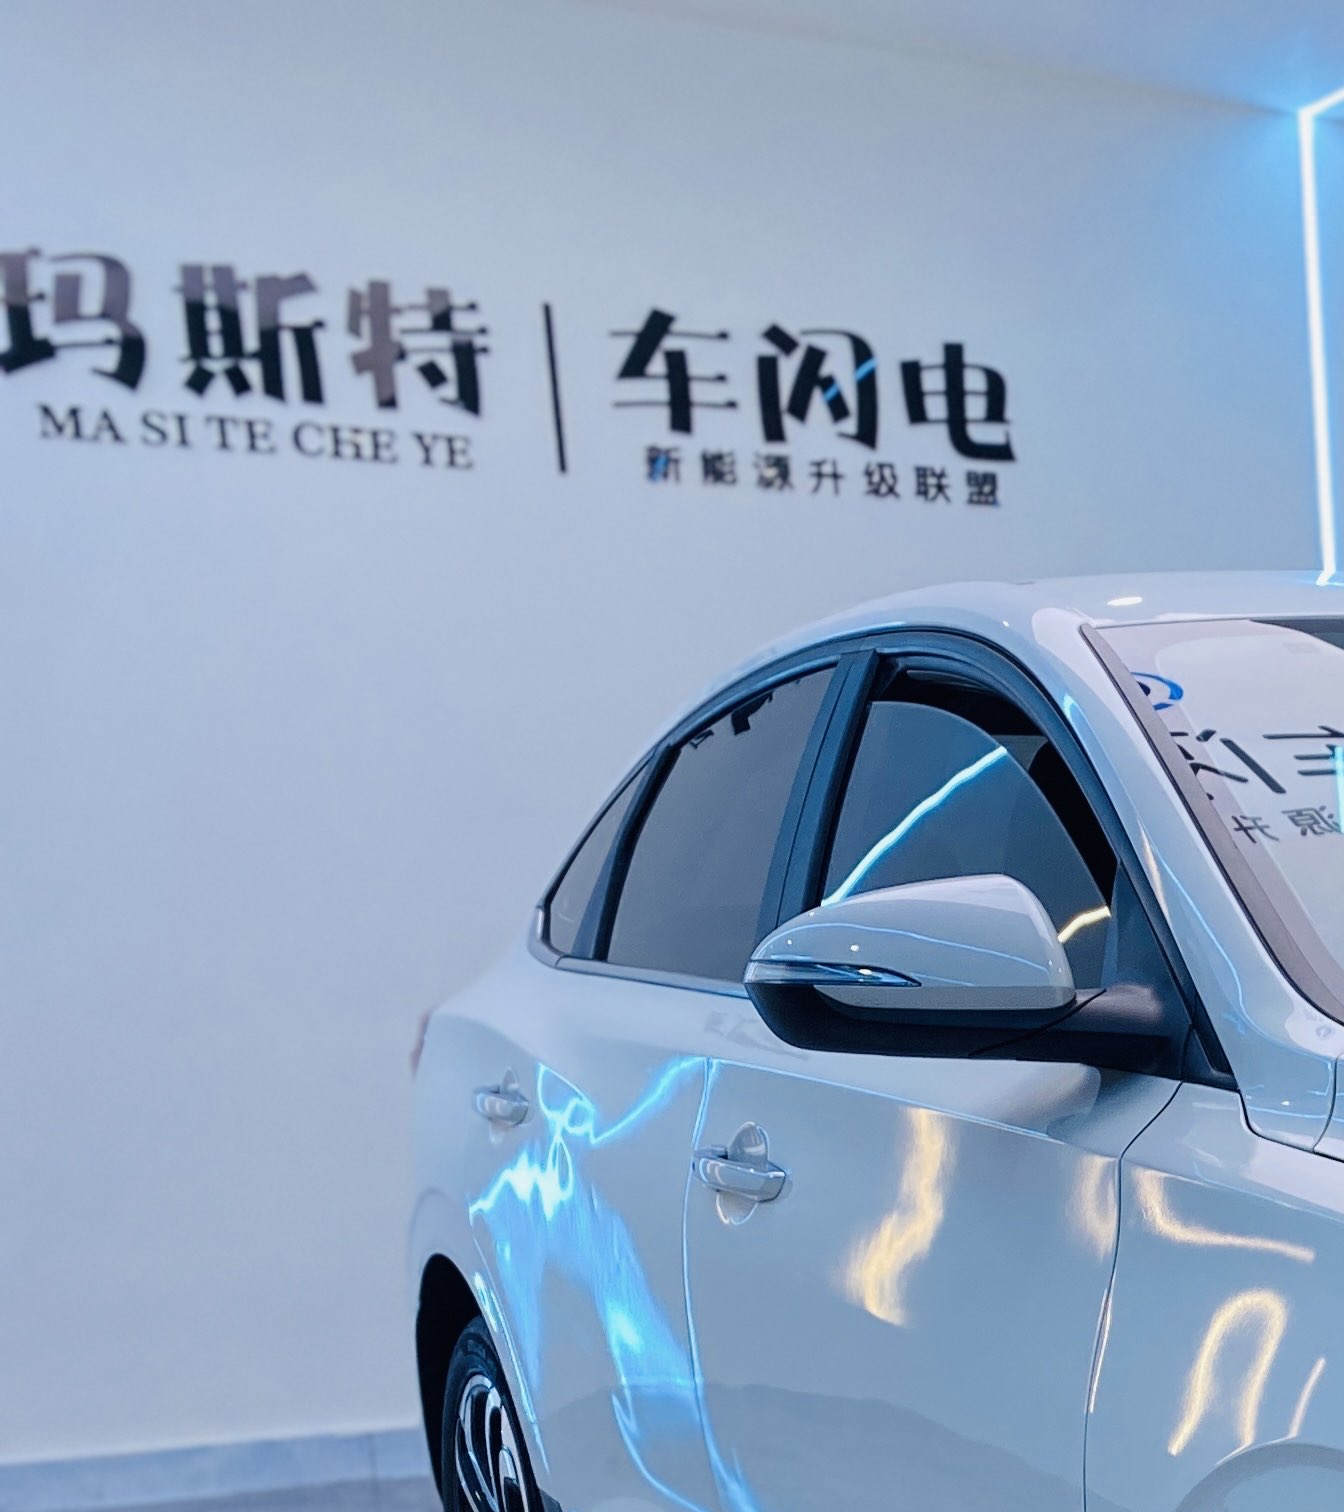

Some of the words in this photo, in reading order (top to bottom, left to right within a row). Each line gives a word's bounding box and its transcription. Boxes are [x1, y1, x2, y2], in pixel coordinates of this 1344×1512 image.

[608, 307, 1017, 462] 车闪电
[37, 403, 128, 445] MA
[140, 410, 193, 449] SI
[205, 414, 277, 454] TE
[291, 420, 399, 465] CHE
[411, 430, 475, 470] YE
[645, 445, 1002, 507] 新能源升级联盟
